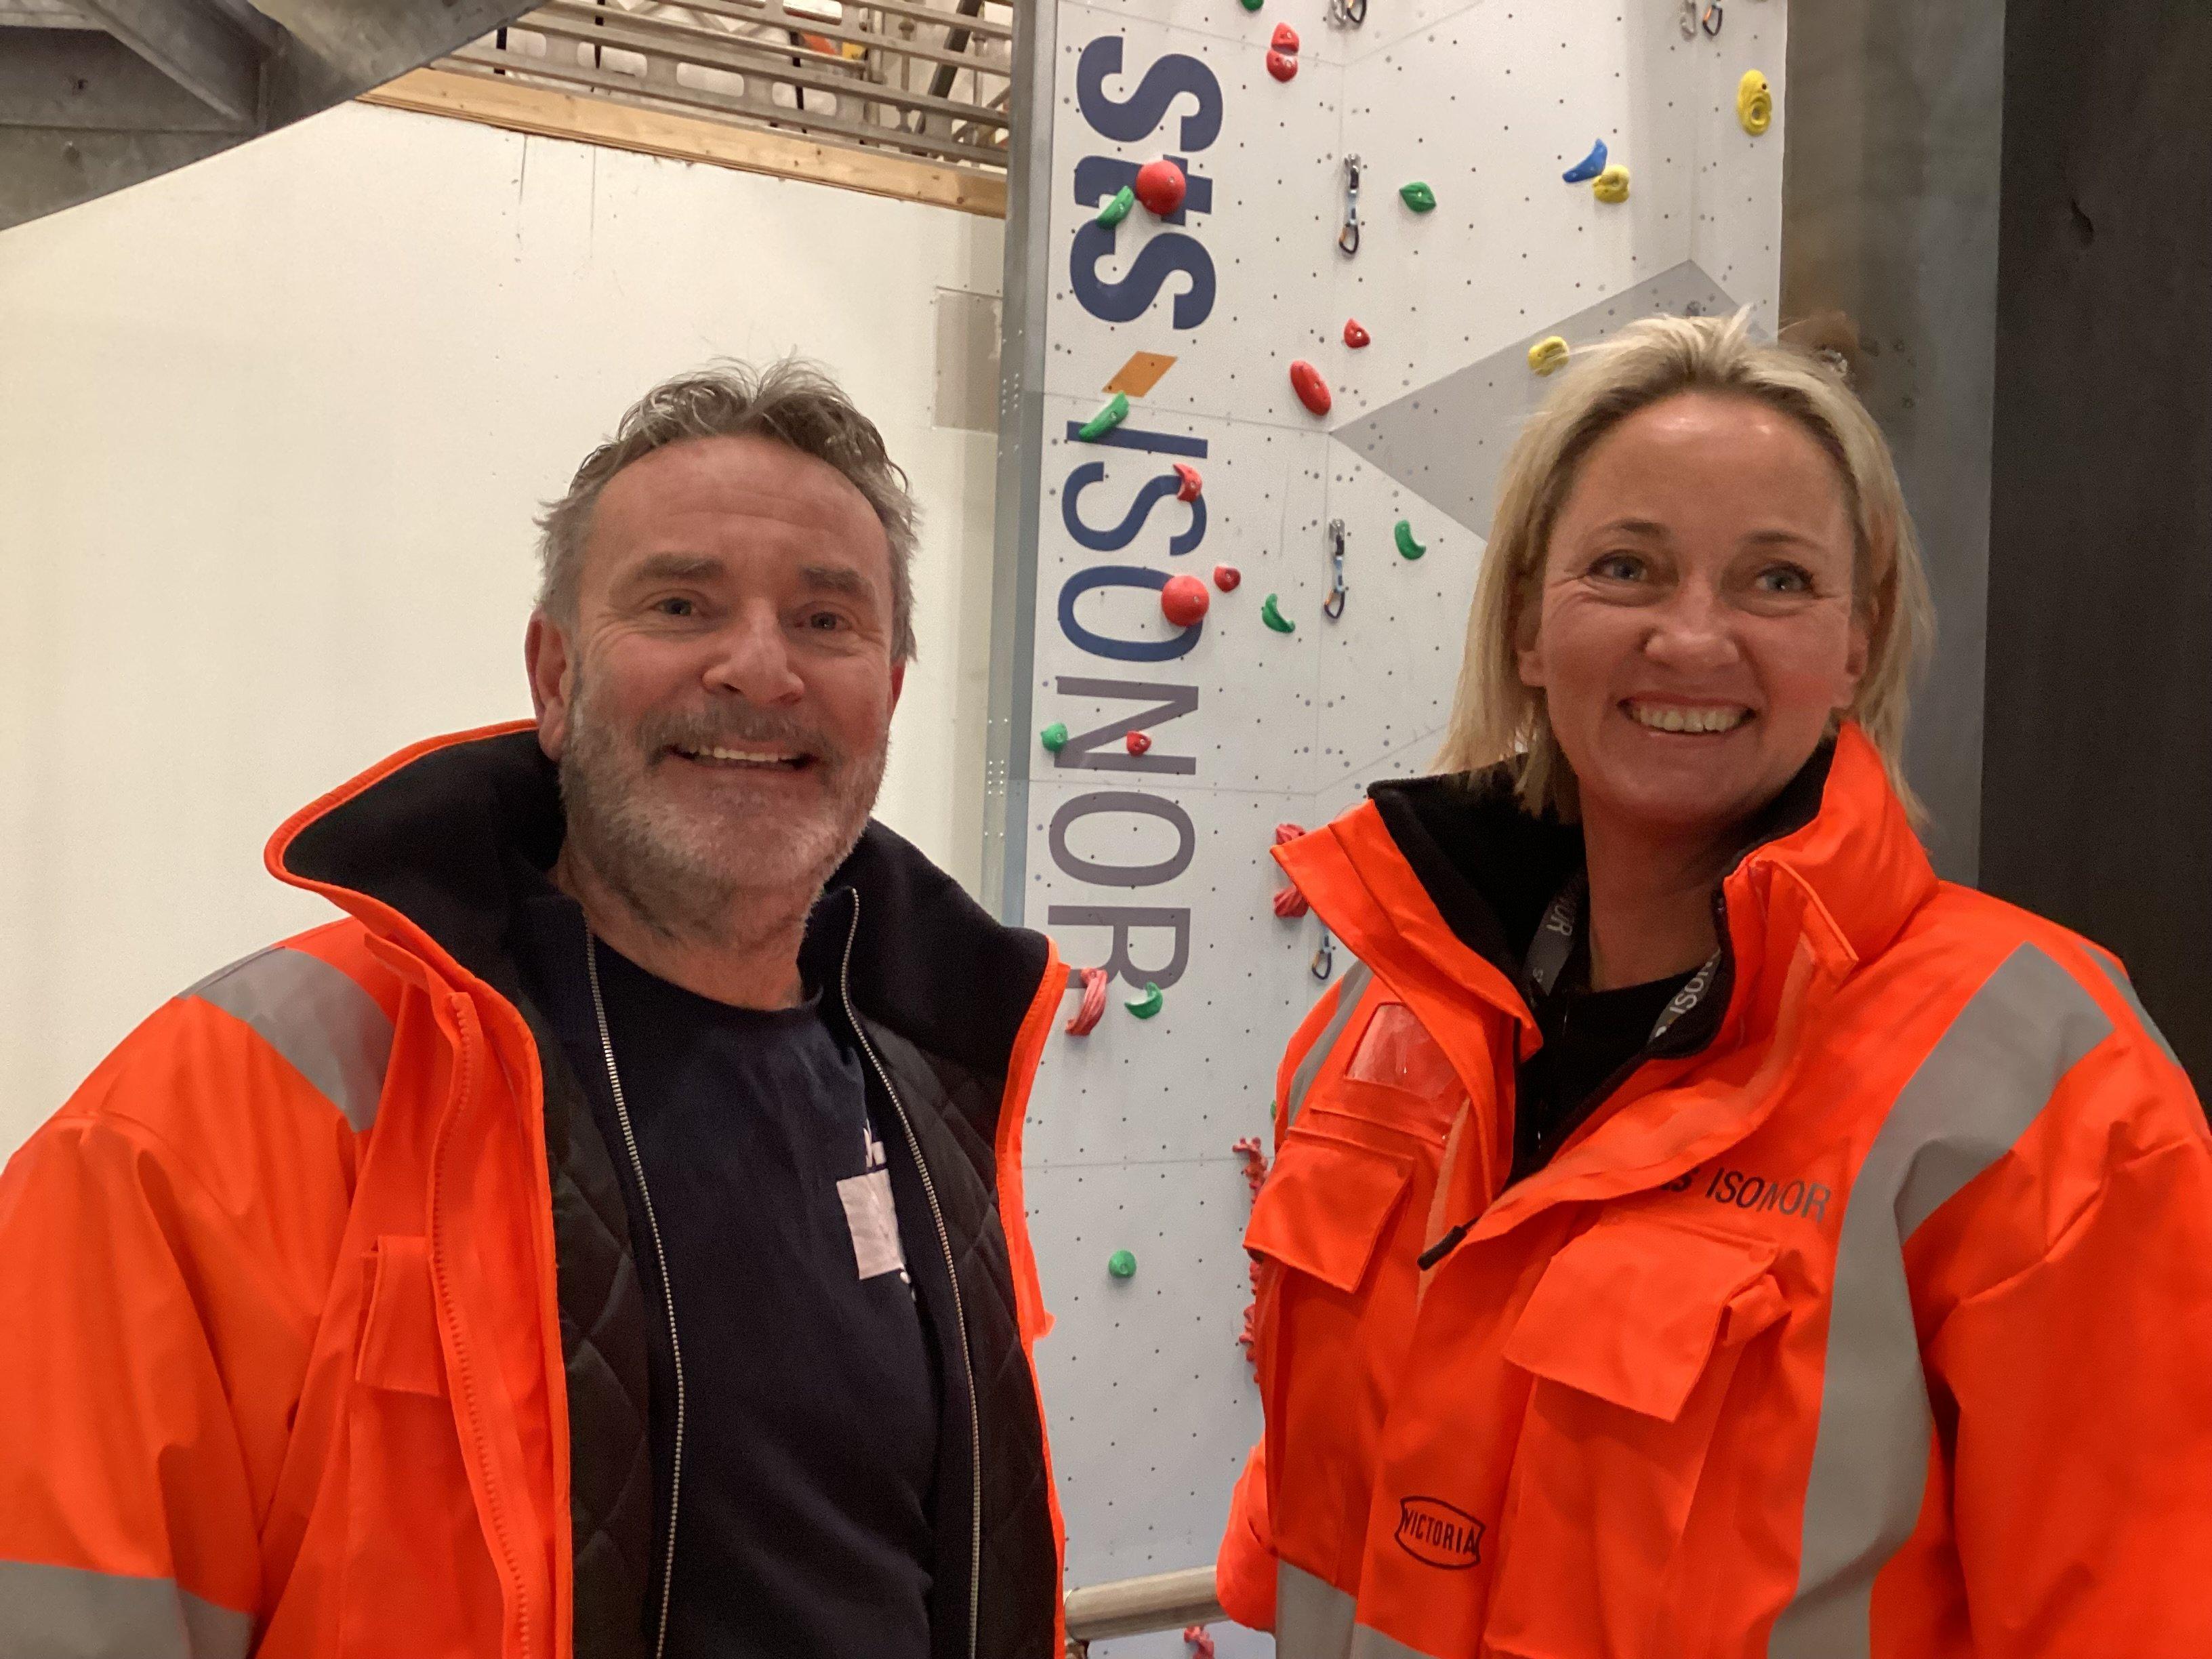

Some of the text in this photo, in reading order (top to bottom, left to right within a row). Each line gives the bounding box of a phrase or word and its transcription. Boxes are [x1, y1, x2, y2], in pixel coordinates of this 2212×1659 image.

[1047, 419, 1208, 991] ISONOR
[1705, 1166, 1830, 1224] ISONOR
[1403, 1507, 1477, 1556] VICTORIA
